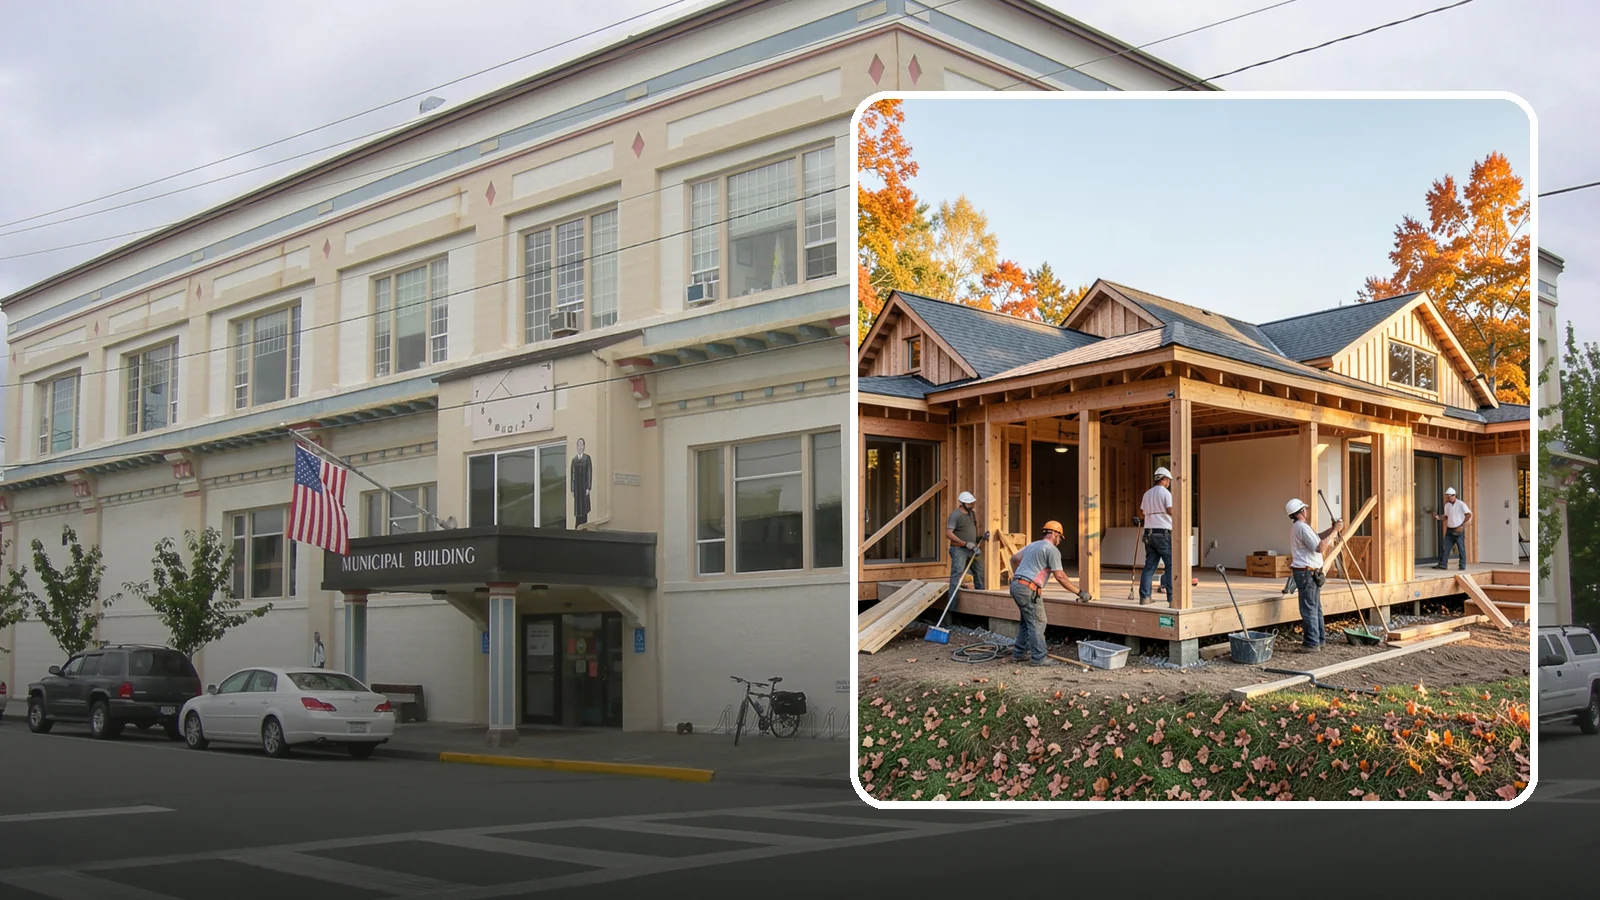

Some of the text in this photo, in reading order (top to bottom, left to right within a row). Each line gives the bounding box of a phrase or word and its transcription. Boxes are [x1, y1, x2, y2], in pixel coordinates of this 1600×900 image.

[488, 418, 492, 426] 9
[547, 362, 551, 370] 6
[342, 546, 475, 572] MUNICIPAL BUILDING
